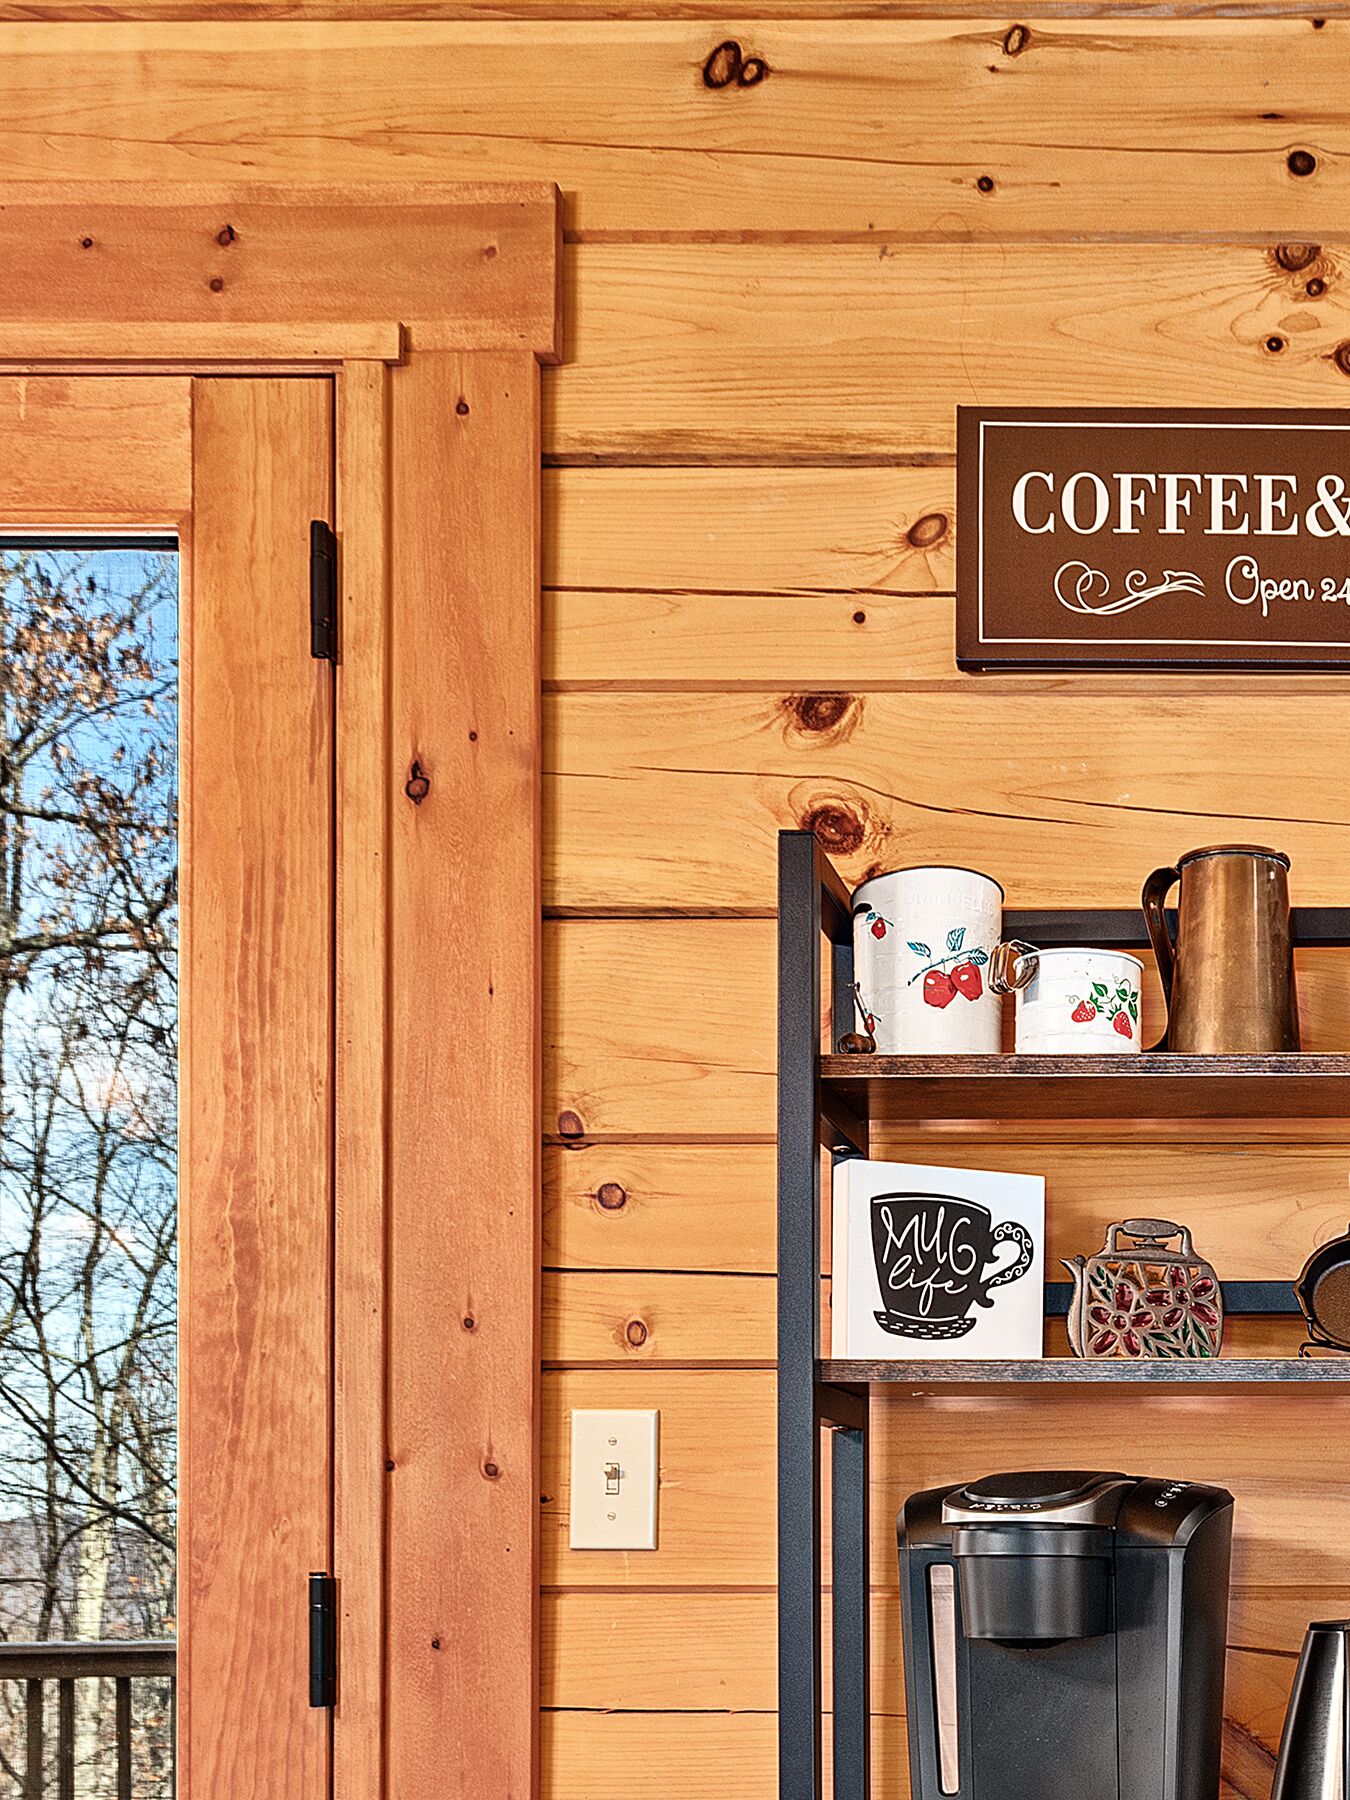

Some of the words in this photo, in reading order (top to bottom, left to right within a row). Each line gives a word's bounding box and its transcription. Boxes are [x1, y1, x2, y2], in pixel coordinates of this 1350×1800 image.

[1225, 555, 1315, 617] Open
[880, 1205, 977, 1276] MUG
[888, 1254, 968, 1317] life
